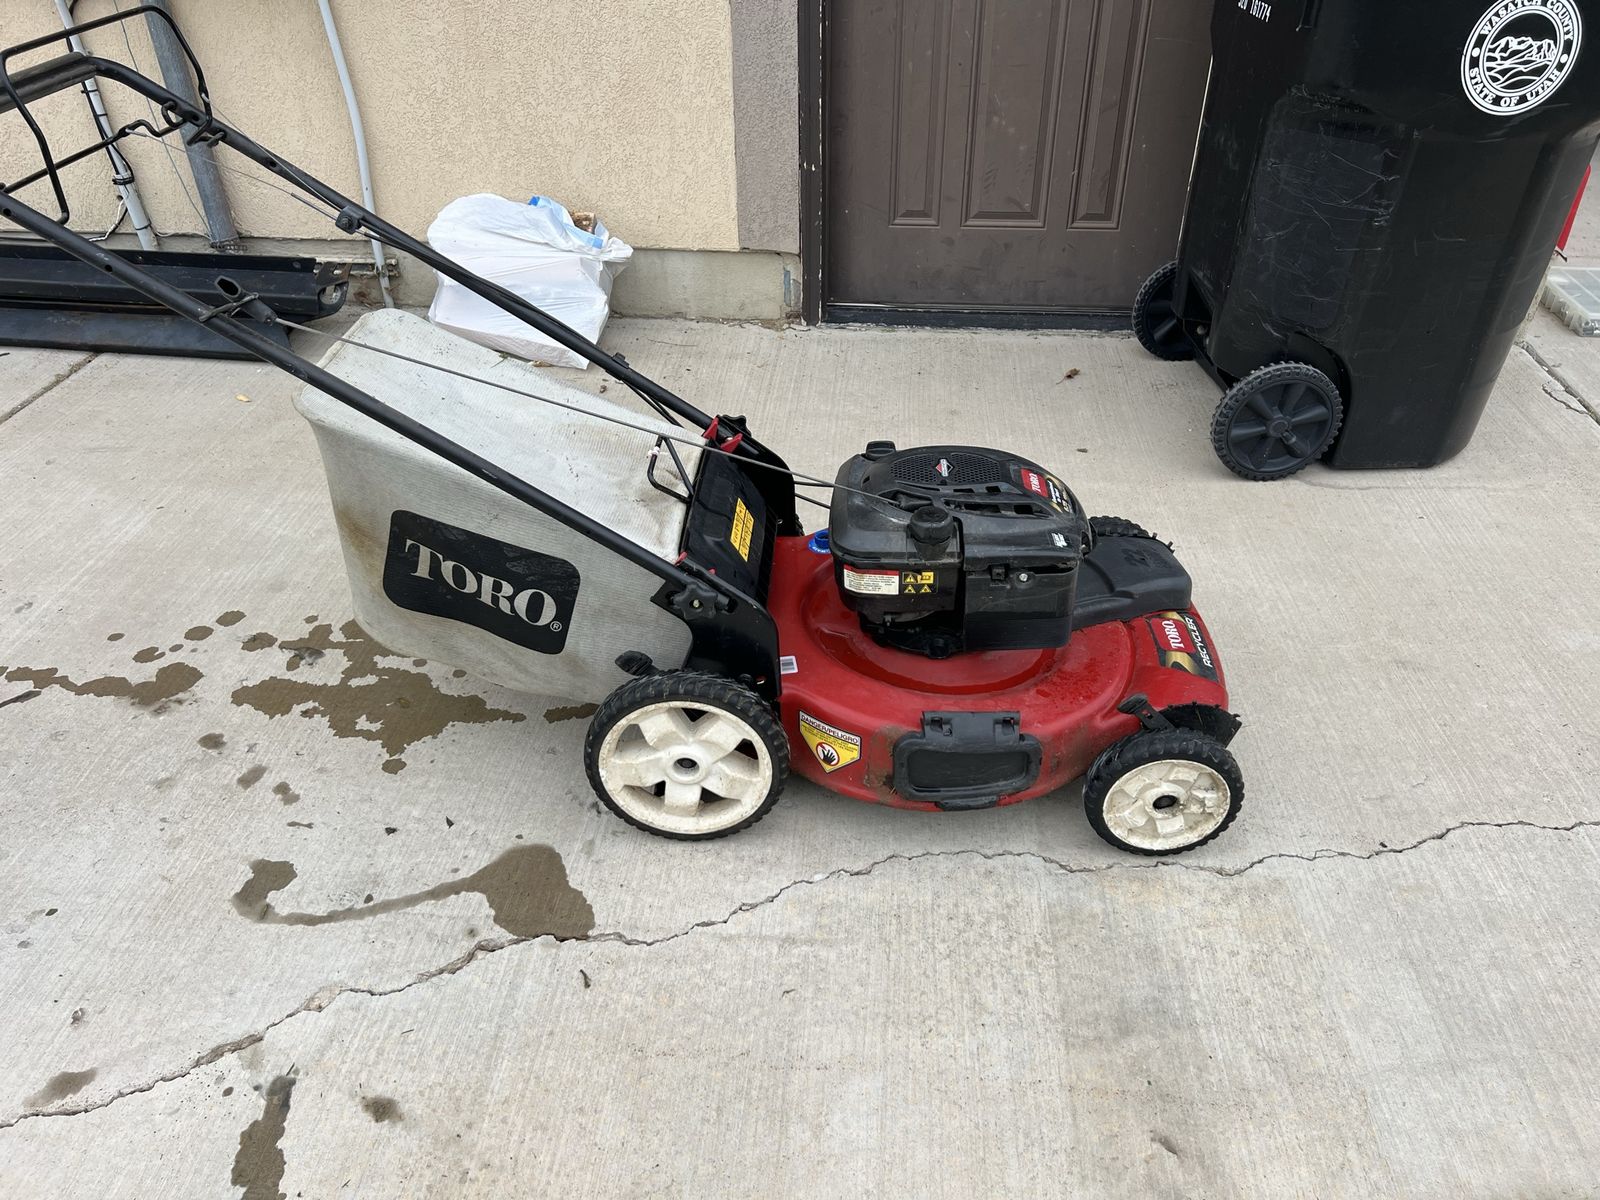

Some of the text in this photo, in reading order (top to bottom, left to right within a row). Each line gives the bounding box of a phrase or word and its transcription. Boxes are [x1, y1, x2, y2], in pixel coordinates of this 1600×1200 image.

[1480, 0, 1573, 40] WASATCH COUNTY
[1469, 67, 1560, 107] STATE OF UTAH
[1029, 472, 1041, 492] TORO
[405, 539, 557, 626] TORO
[1161, 619, 1185, 649] TORO
[1184, 615, 1213, 668] RECYCLER
